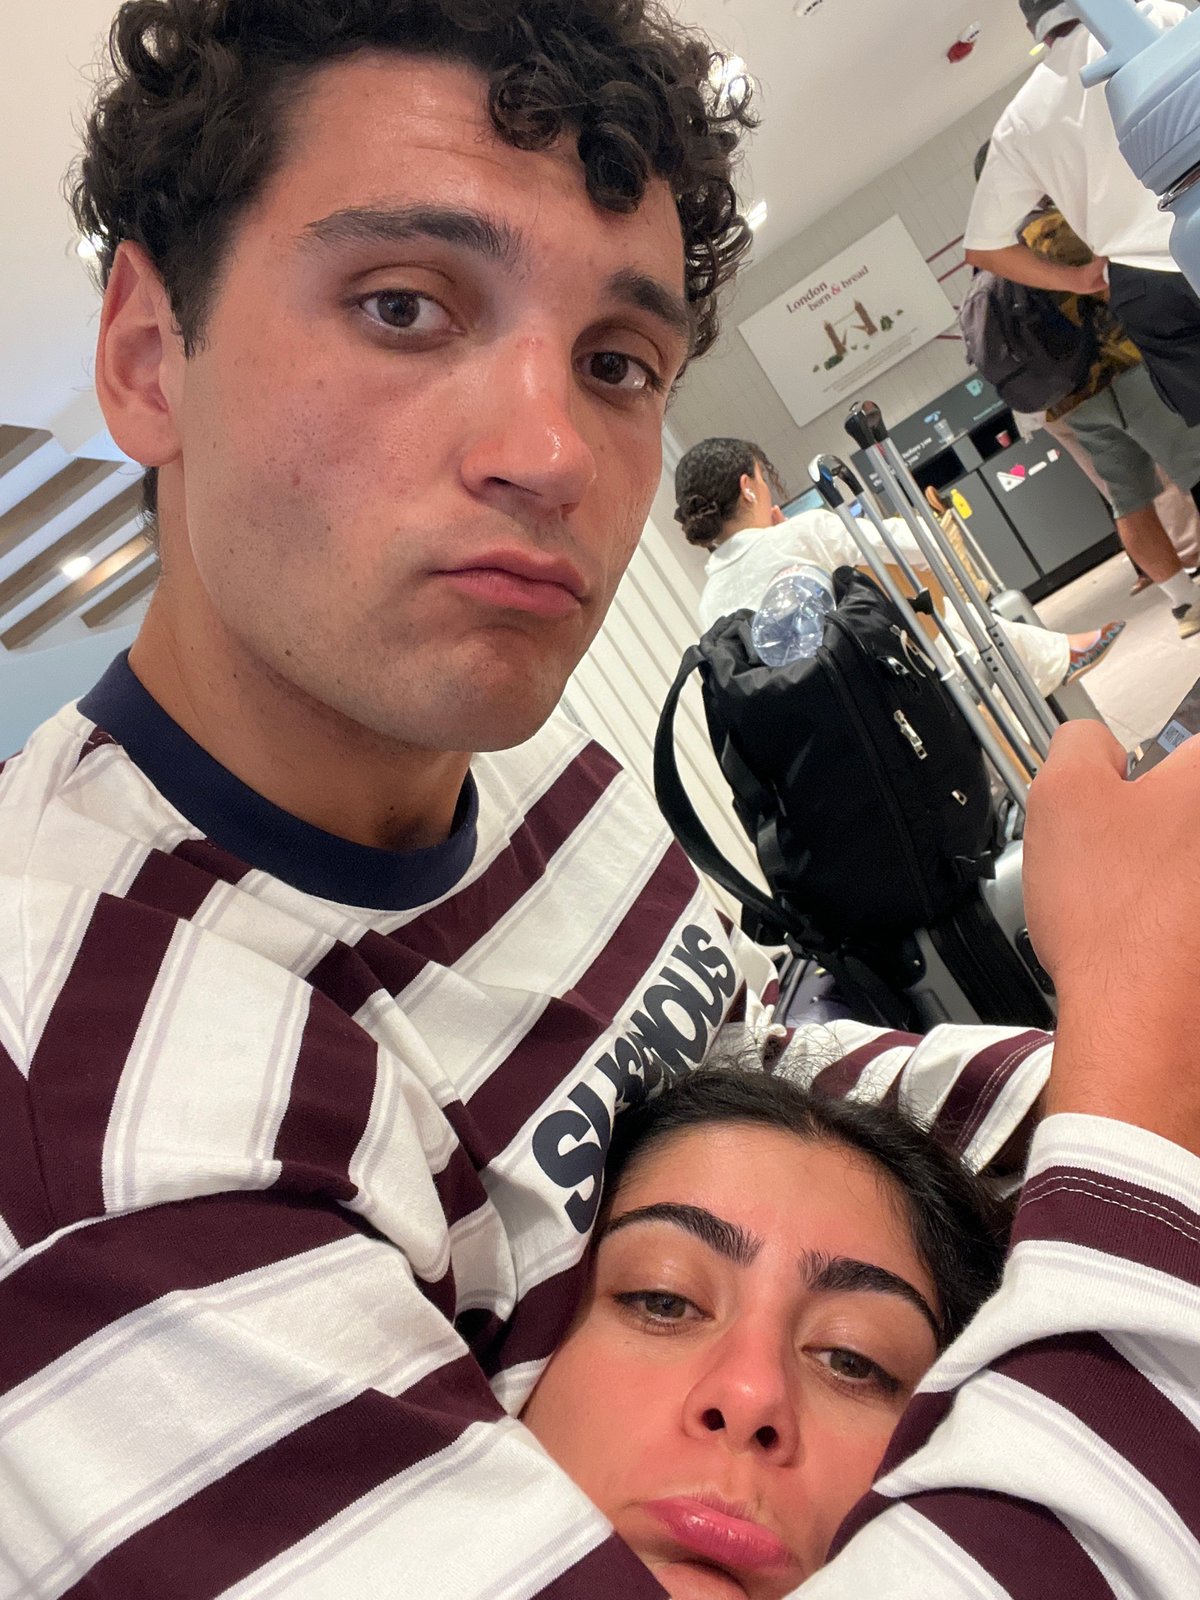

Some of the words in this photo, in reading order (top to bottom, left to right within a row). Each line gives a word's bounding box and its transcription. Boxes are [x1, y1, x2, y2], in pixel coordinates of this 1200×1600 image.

[786, 282, 828, 314] London
[807, 293, 832, 311] born
[830, 283, 841, 296] &
[841, 265, 869, 288] bread
